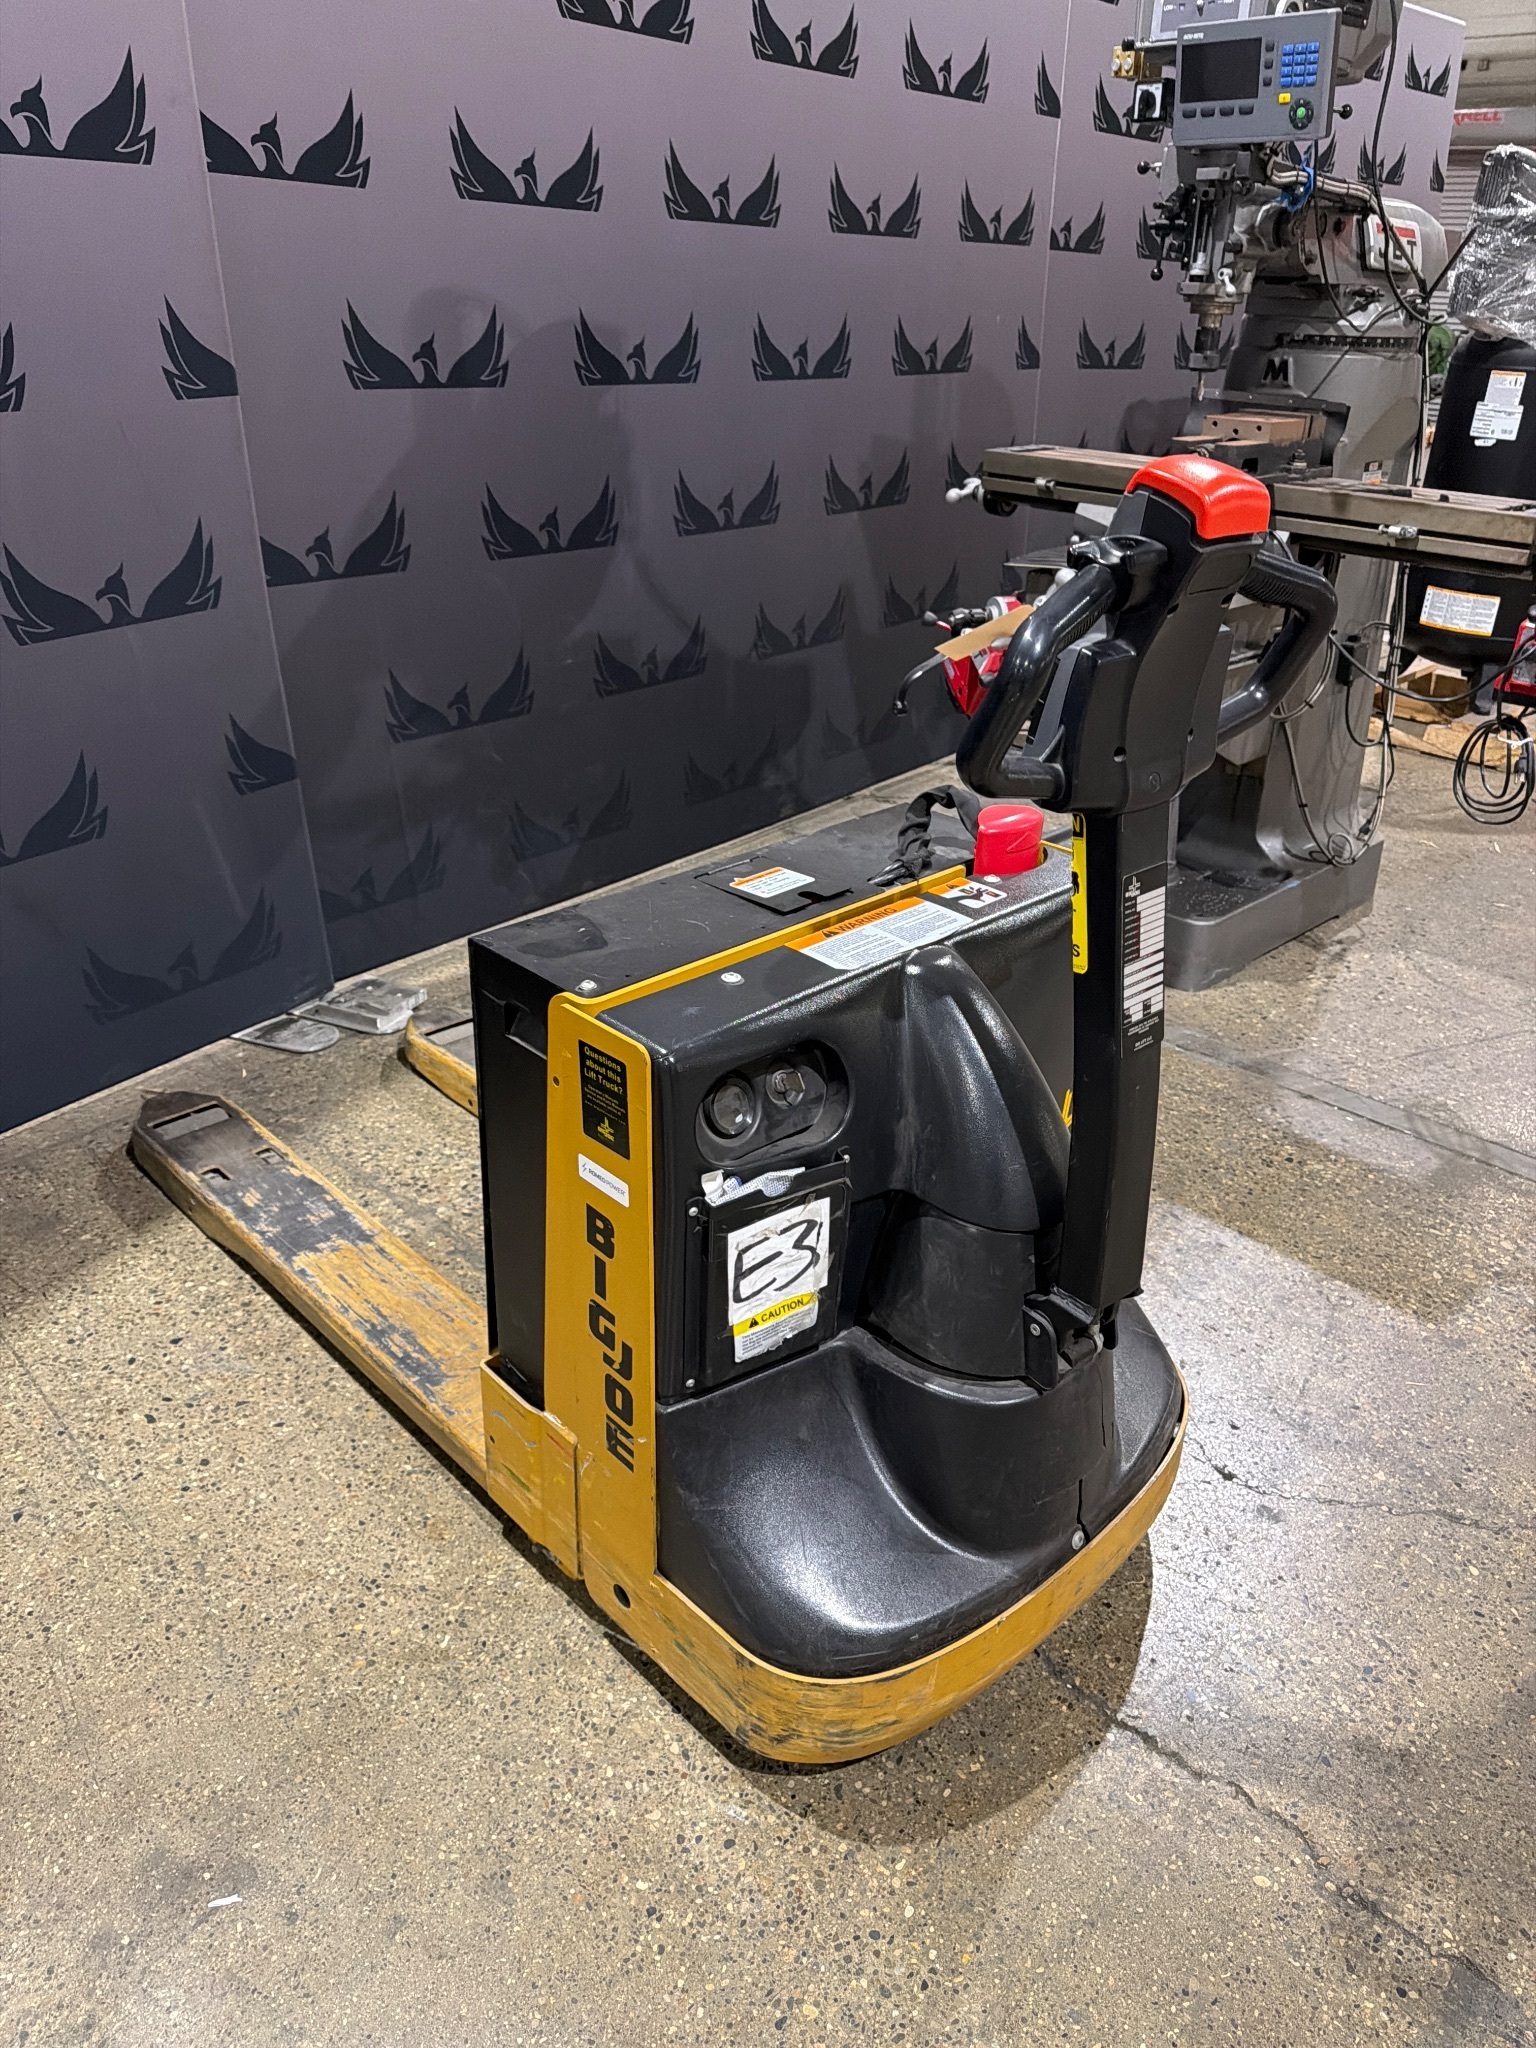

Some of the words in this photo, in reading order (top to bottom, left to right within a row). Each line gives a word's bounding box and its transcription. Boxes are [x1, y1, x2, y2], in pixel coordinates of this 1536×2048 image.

[834, 907, 898, 932] WARNING
[584, 1046, 621, 1072] Questions
[586, 1059, 606, 1075] about
[607, 1069, 622, 1083] this
[584, 1067, 597, 1080] Lift
[598, 1074, 623, 1095] Truck?
[733, 1218, 822, 1304] E3
[761, 1297, 804, 1322] CAUTION
